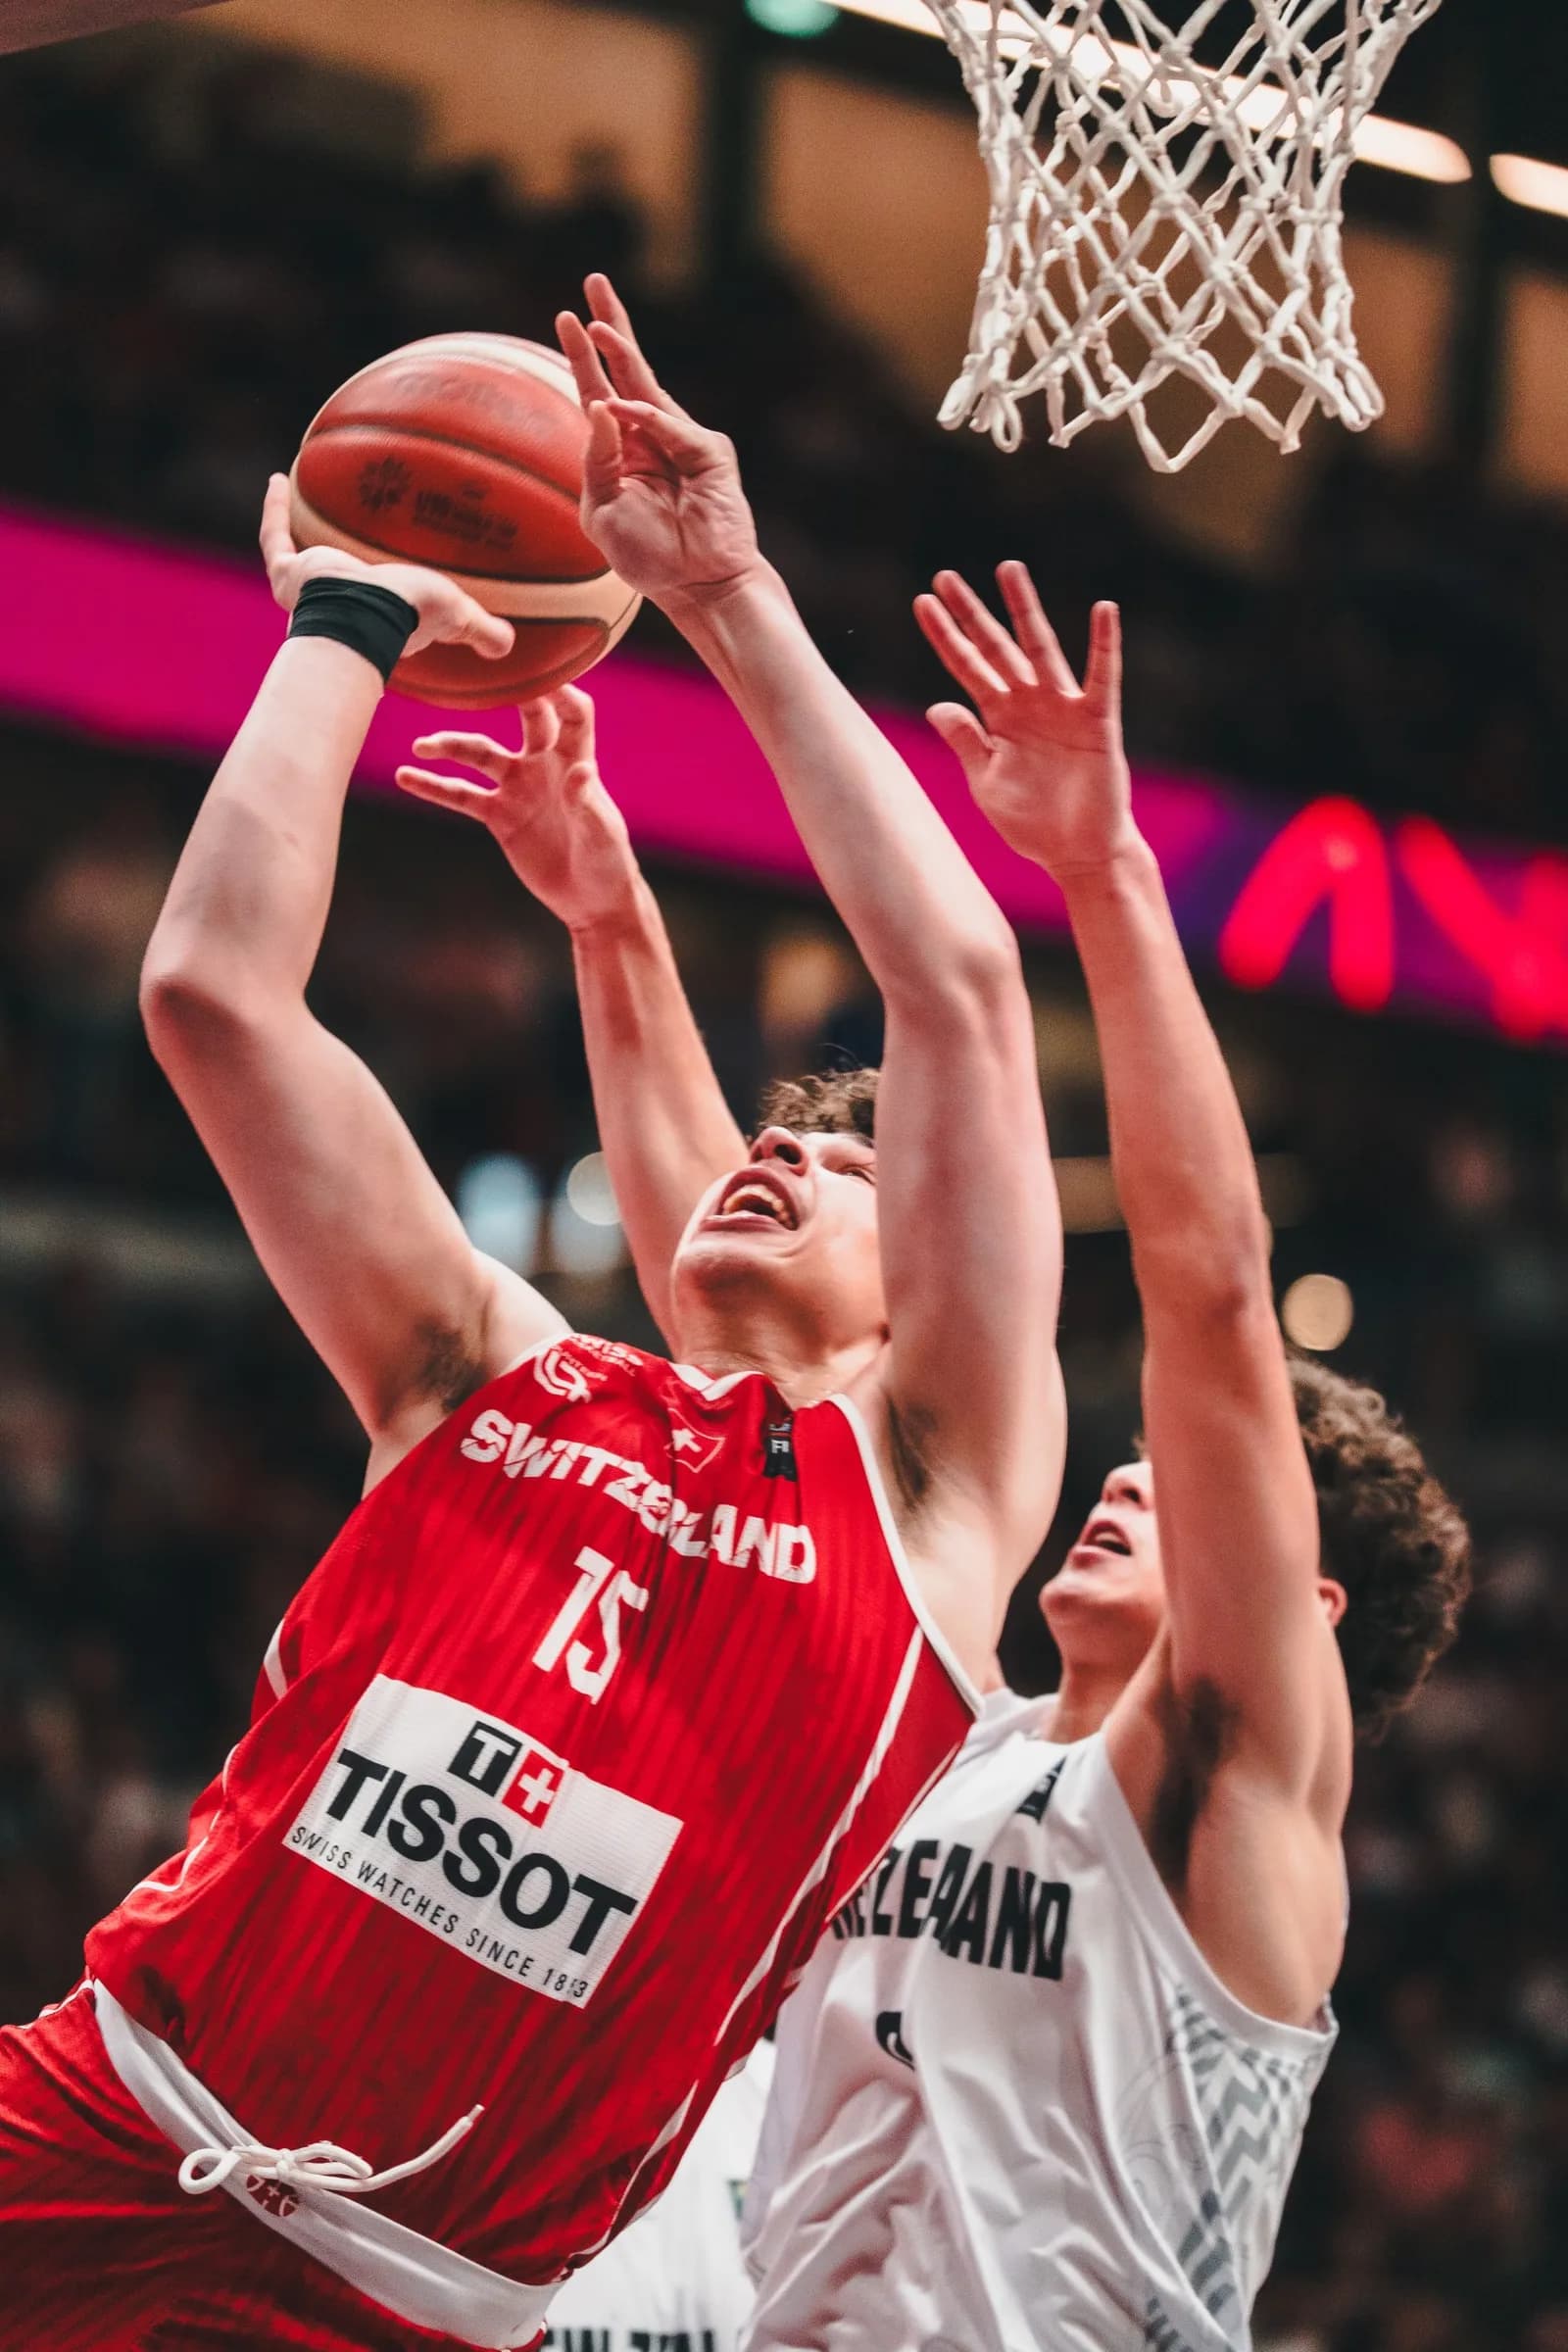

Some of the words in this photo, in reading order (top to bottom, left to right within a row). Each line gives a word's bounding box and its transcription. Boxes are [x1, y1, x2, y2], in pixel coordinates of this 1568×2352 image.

[532, 1545, 649, 1705] 15
[292, 1827, 353, 1870] SWISS
[357, 1861, 459, 1934] WATCHES
[466, 1928, 535, 1978] SINCE
[326, 1748, 639, 1955] TISSOT
